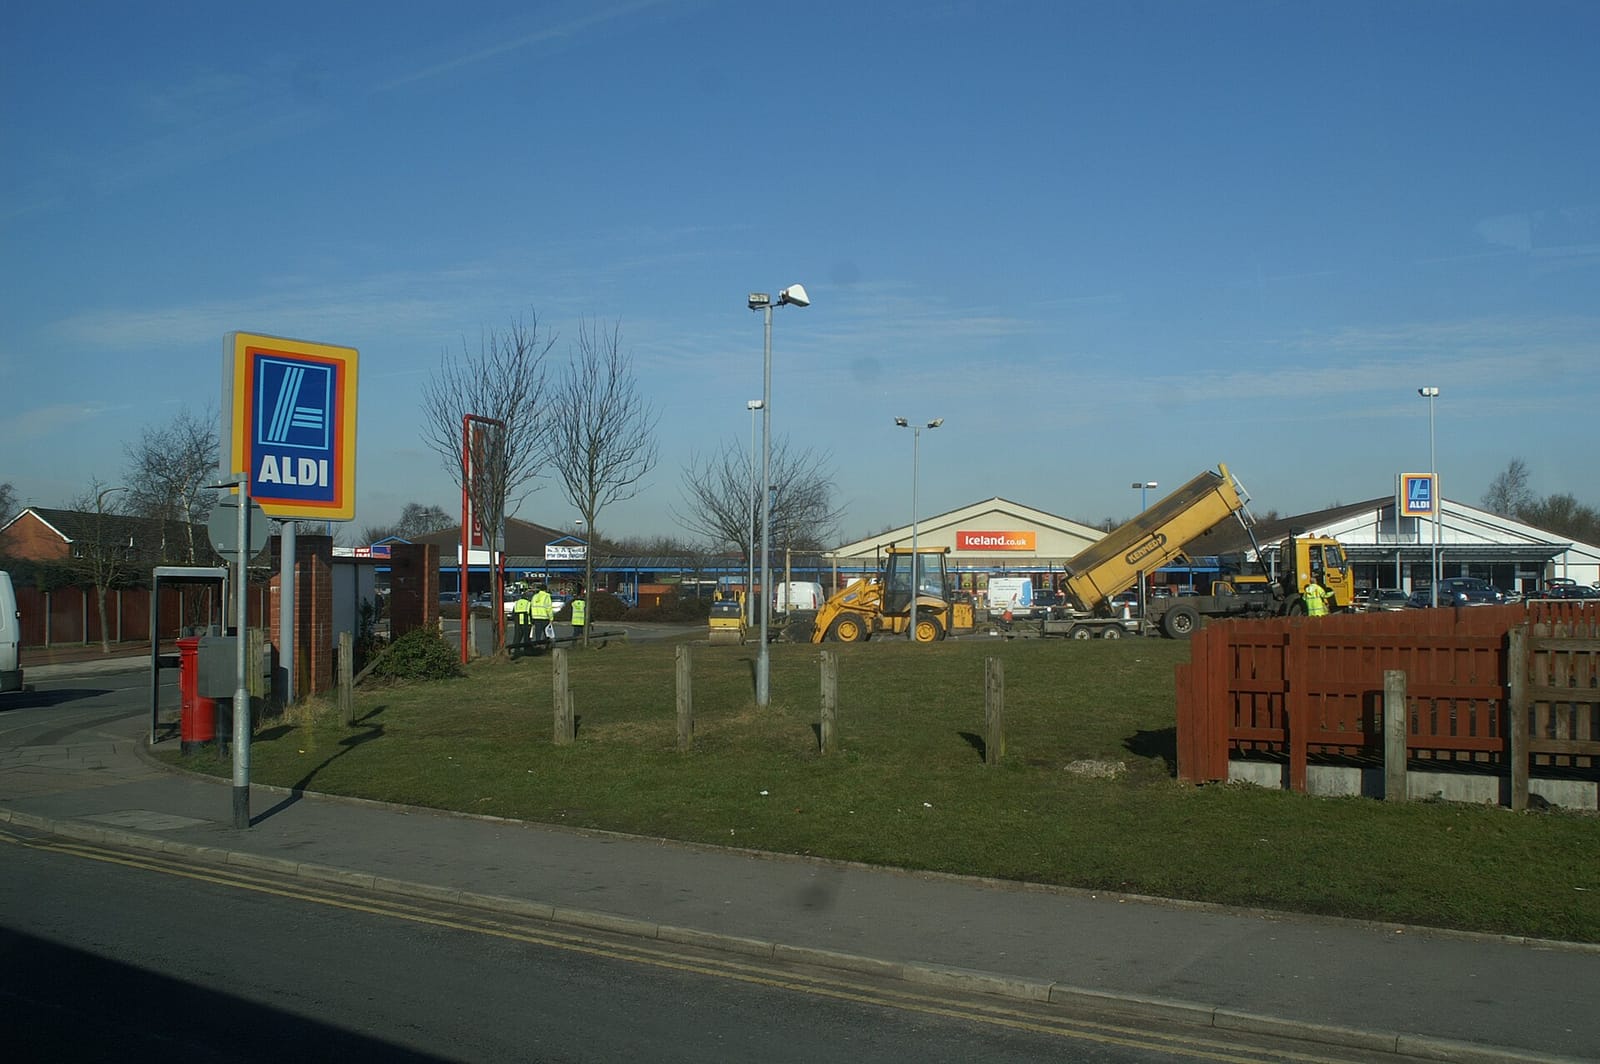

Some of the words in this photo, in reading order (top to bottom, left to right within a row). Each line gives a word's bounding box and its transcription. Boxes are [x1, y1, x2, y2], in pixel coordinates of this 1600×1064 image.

[258, 455, 328, 487] ALDI
[1410, 501, 1430, 509] ALDI
[965, 535, 1027, 546] Iceland.co.uk
[1128, 535, 1163, 563] KENNEDY
